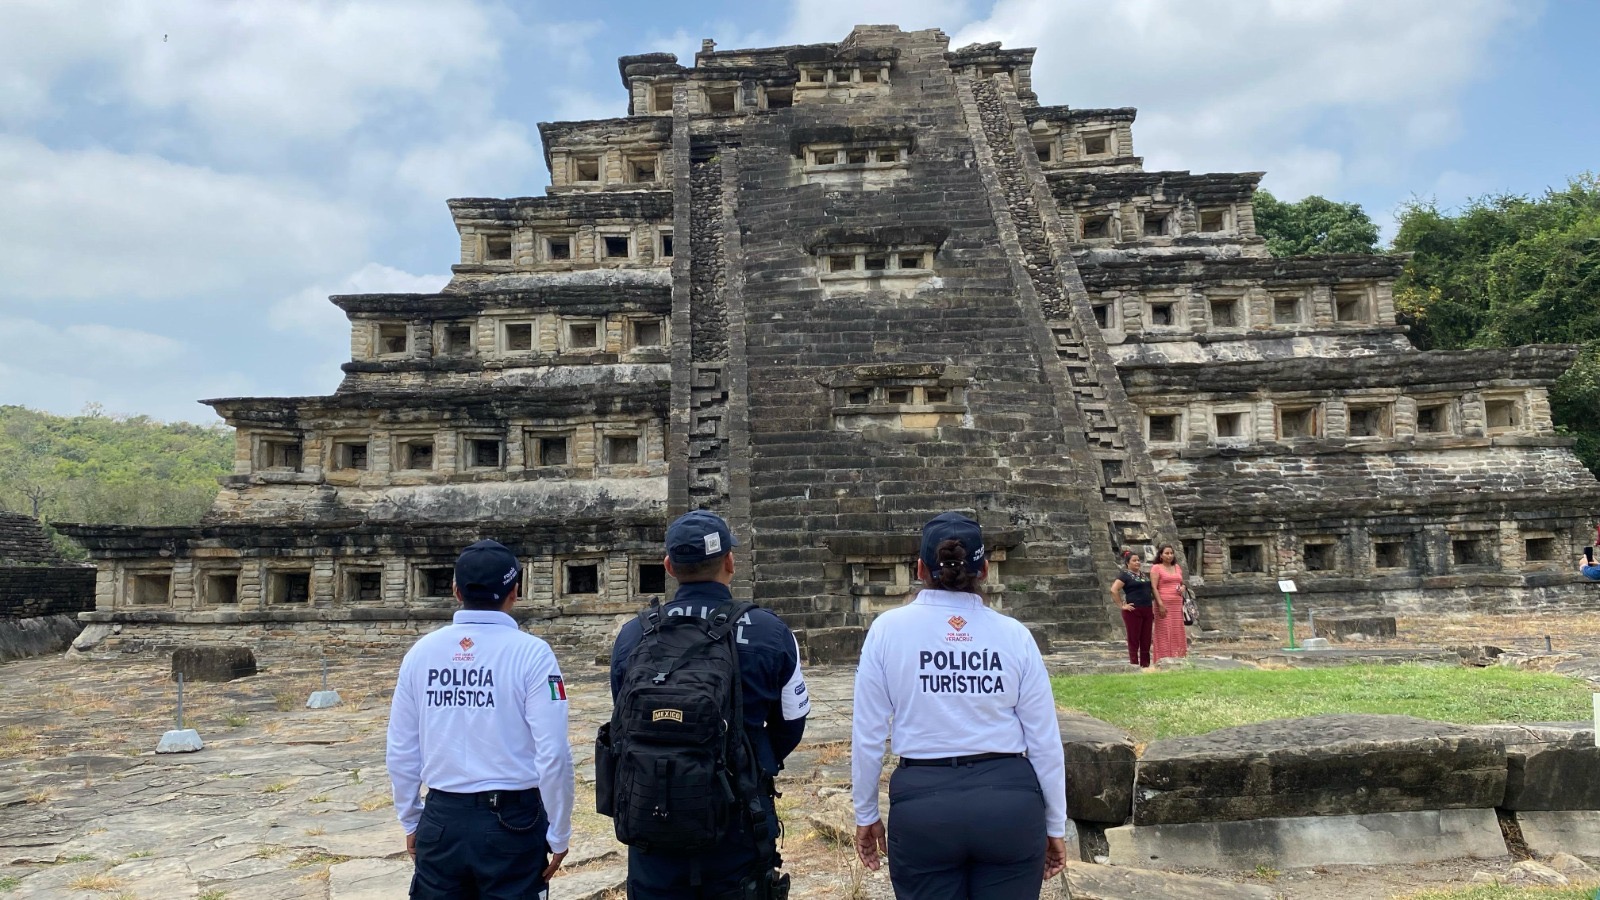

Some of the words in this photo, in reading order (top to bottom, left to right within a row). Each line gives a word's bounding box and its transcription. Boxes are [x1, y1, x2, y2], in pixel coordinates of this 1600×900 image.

[919, 648, 1003, 671] POLICÍA
[427, 666, 494, 687] POLICÍA
[919, 672, 1005, 694] TURÍSTICA
[426, 687, 495, 708] TURÍSTICA
[654, 711, 681, 720] MEXICO
